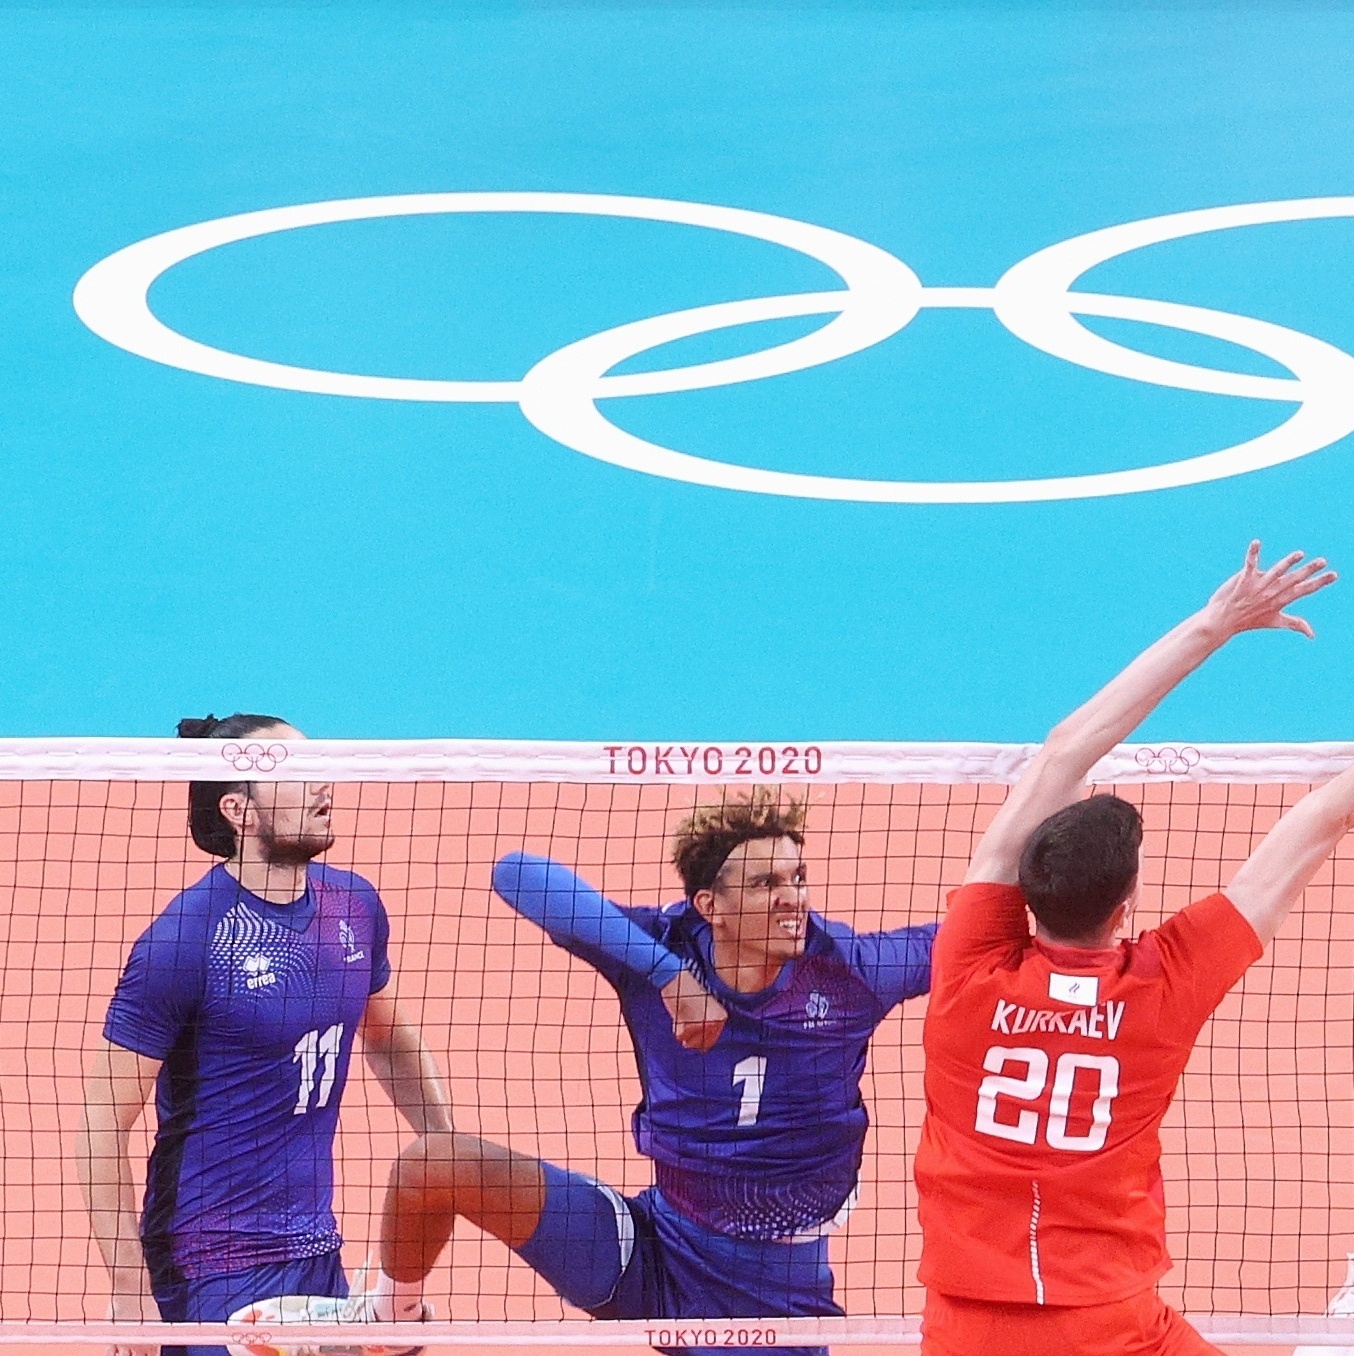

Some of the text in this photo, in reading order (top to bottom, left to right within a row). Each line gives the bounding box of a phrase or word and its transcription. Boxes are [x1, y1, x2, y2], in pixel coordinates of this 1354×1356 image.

[603, 745, 823, 776] TOKYO 2020
[990, 998, 1126, 1041] KURKAEV
[293, 1022, 344, 1115] 11
[732, 1056, 768, 1127] 1
[974, 1045, 1120, 1152] 20
[644, 1328, 777, 1347] TOKYO 2020
